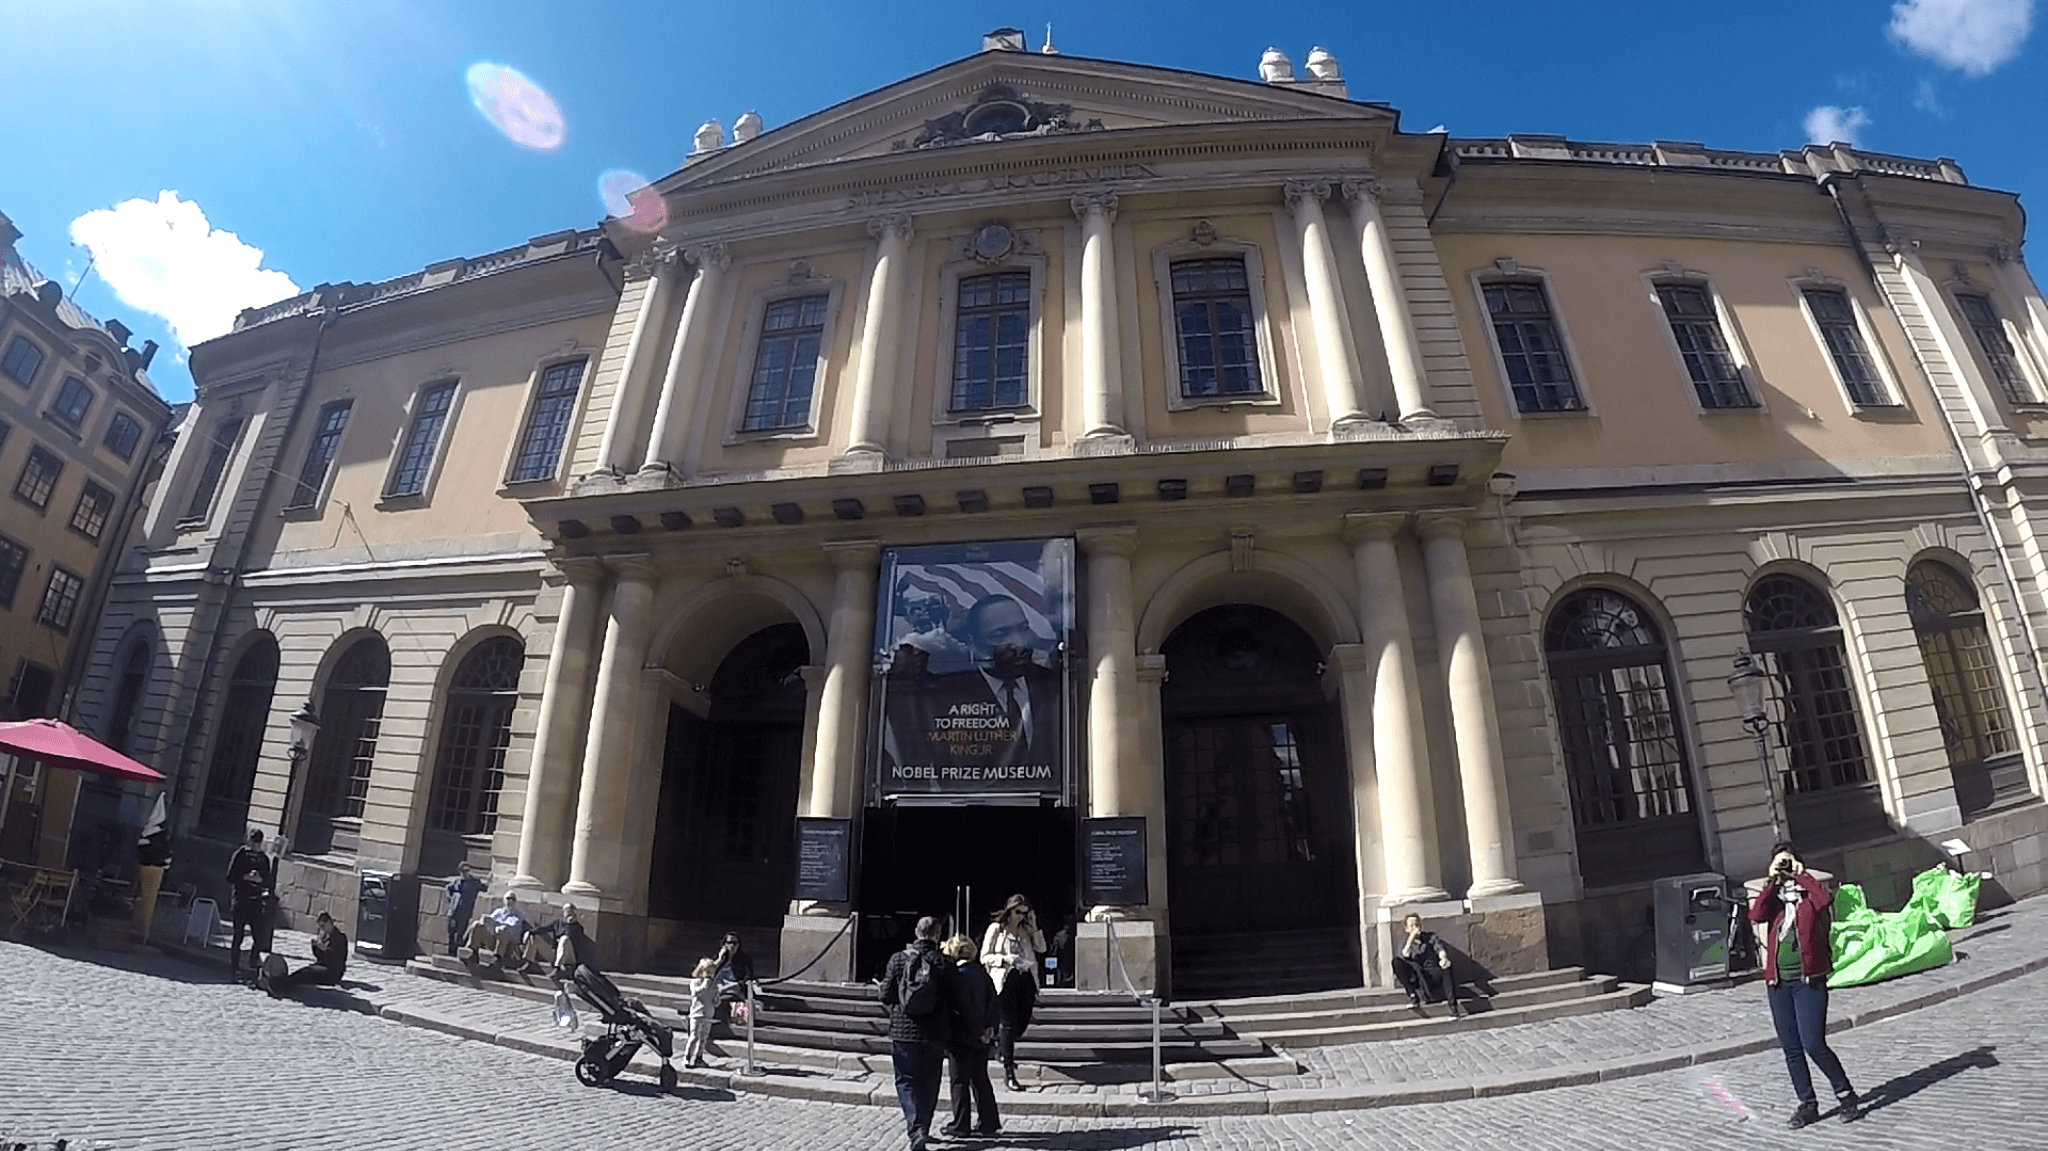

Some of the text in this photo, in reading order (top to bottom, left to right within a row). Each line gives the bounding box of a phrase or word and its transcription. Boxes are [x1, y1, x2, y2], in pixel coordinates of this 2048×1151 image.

[948, 703, 996, 715] A RIGHT
[934, 717, 1010, 729] TO FREEDOM
[927, 730, 1017, 742] MARTIN LUTHER
[949, 744, 978, 756] KING
[892, 765, 1052, 780] NOBEL PRIZE MUSEUM
